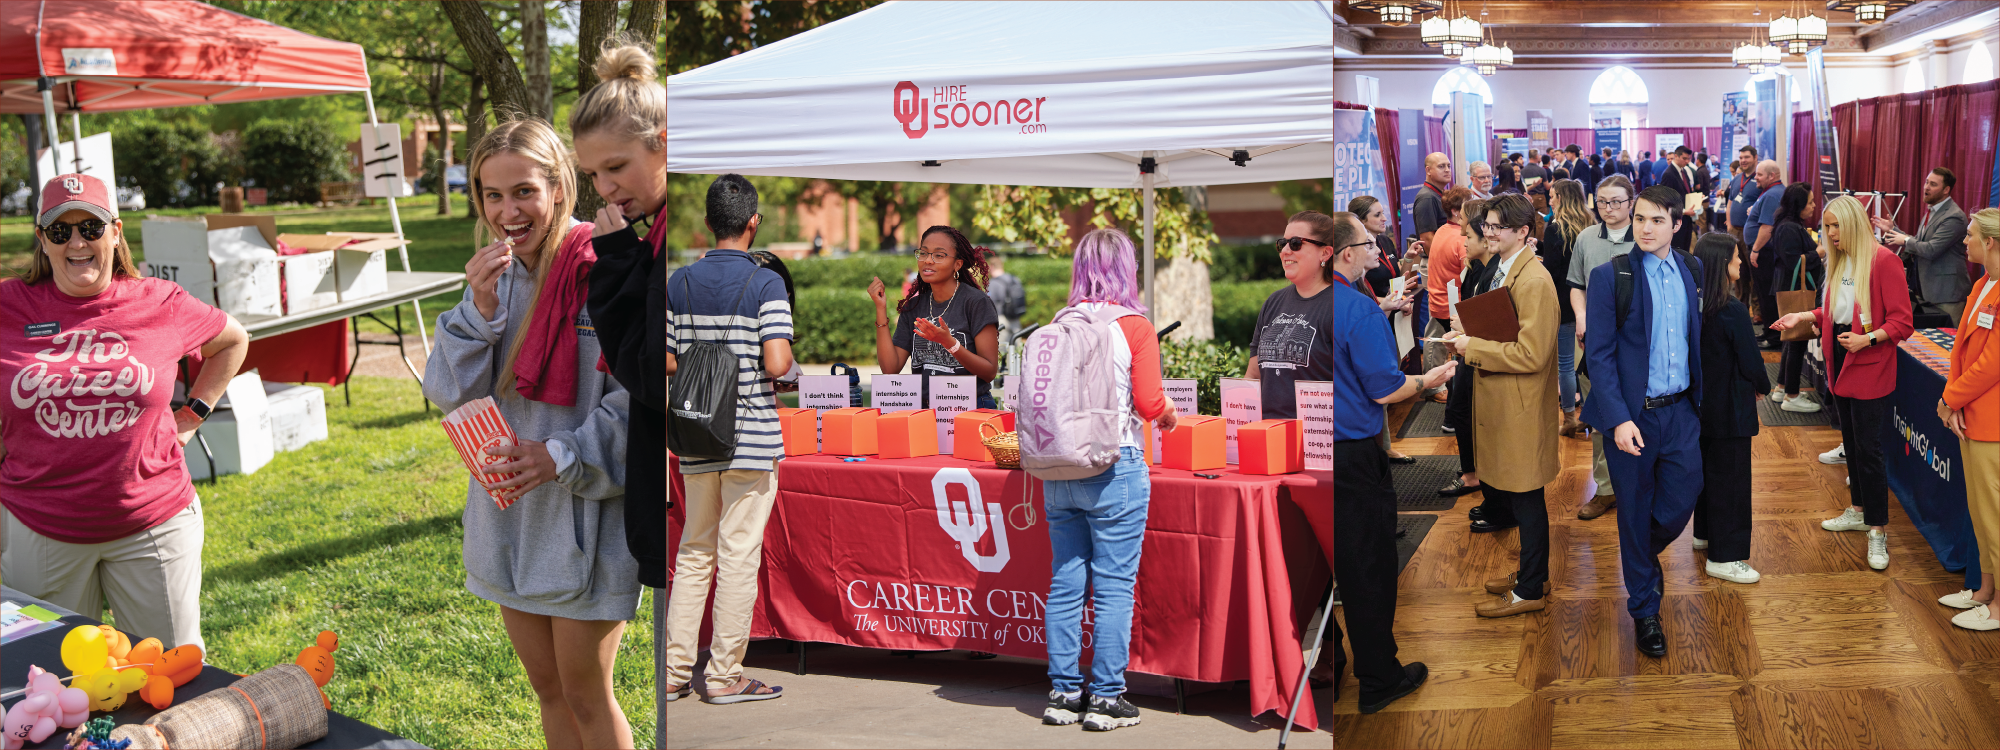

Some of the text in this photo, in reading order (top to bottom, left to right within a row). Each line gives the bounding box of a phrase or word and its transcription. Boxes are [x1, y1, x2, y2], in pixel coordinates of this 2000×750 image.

[934, 84, 967, 103] HIRE
[933, 96, 1046, 129] sooner
[1018, 123, 1047, 135] .com
[34, 328, 130, 364] The
[10, 355, 155, 410] Career
[1032, 334, 1058, 421] Reebok
[935, 393, 970, 401] internships
[1243, 403, 1257, 411] have
[34, 398, 146, 438] Center
[1304, 451, 1332, 461] fellowship
[1308, 441, 1326, 449] co-op,
[846, 579, 979, 616] CAREER
[853, 613, 879, 632] The
[884, 614, 989, 640] UNIVERSITY
[993, 623, 1012, 646] of
